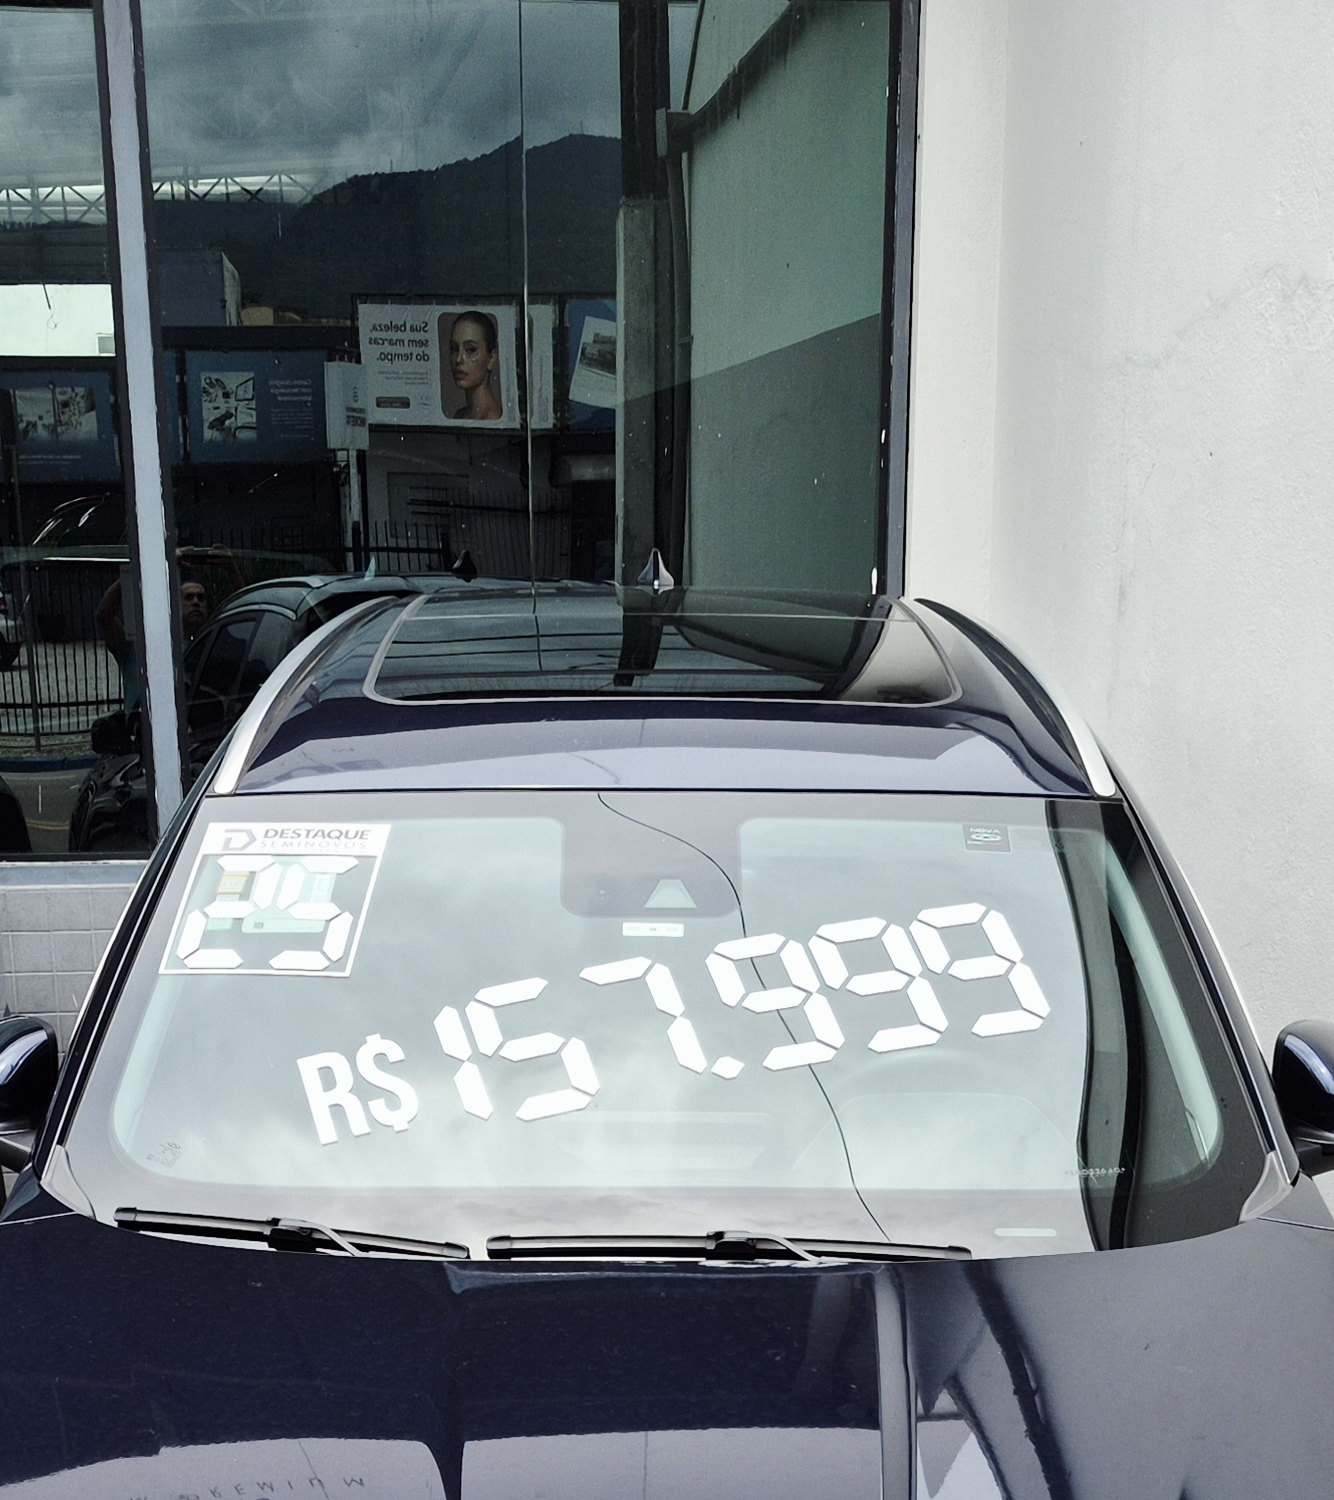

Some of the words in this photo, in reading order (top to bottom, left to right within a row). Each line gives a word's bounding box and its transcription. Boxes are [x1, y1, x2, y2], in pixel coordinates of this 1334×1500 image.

[263, 828, 371, 840] DESTAQUE
[260, 840, 367, 849] SEMINOVOS
[296, 1034, 420, 1146] R$
